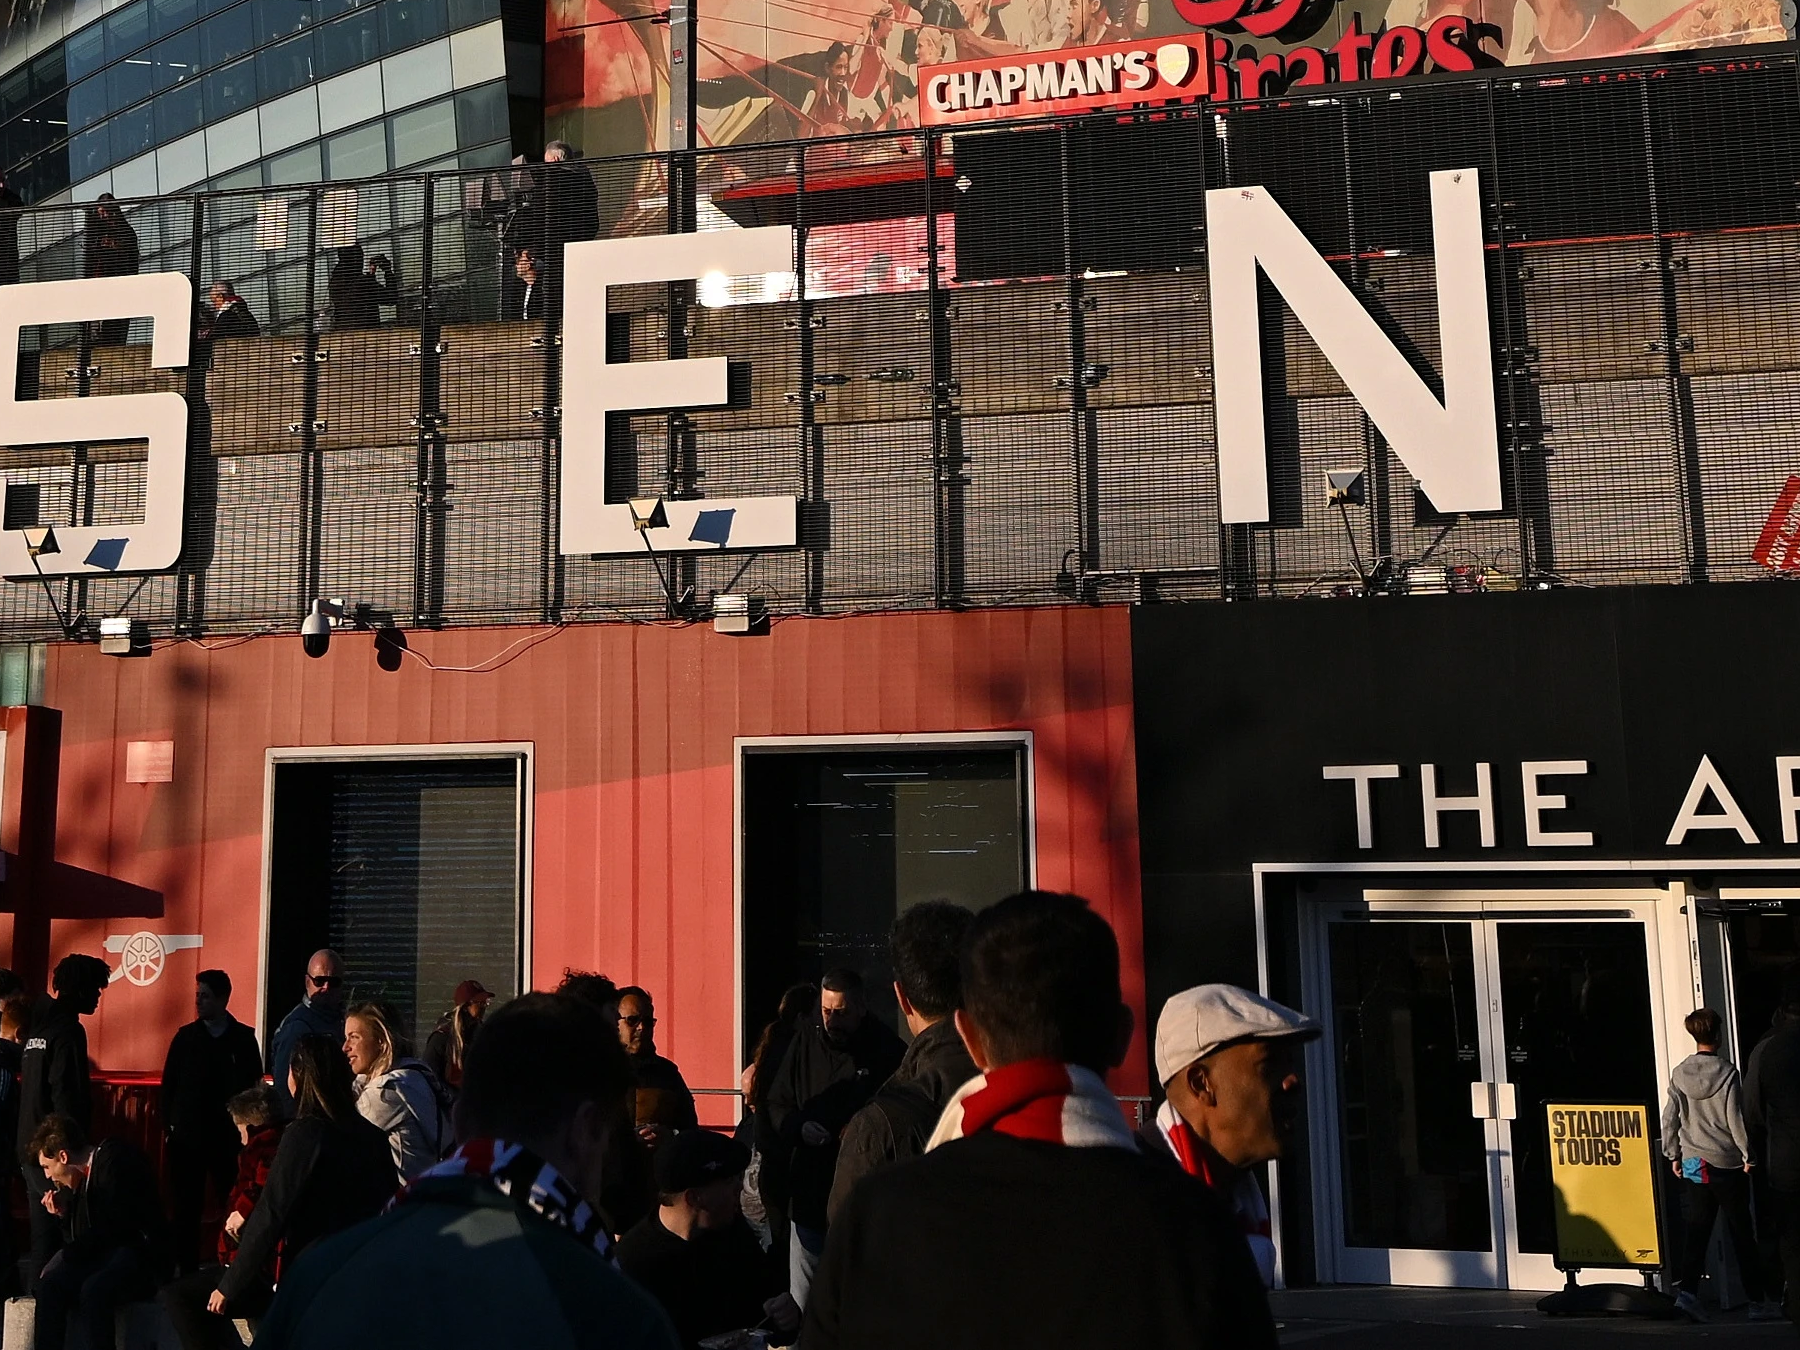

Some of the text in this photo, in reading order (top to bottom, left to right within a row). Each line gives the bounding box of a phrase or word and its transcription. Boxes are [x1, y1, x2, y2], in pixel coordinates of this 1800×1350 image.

[927, 50, 1152, 113] CHAPMAN'S
[1322, 759, 1595, 850] THE
[1551, 1110, 1642, 1138] STADIUM
[1554, 1138, 1622, 1166] TOURS
